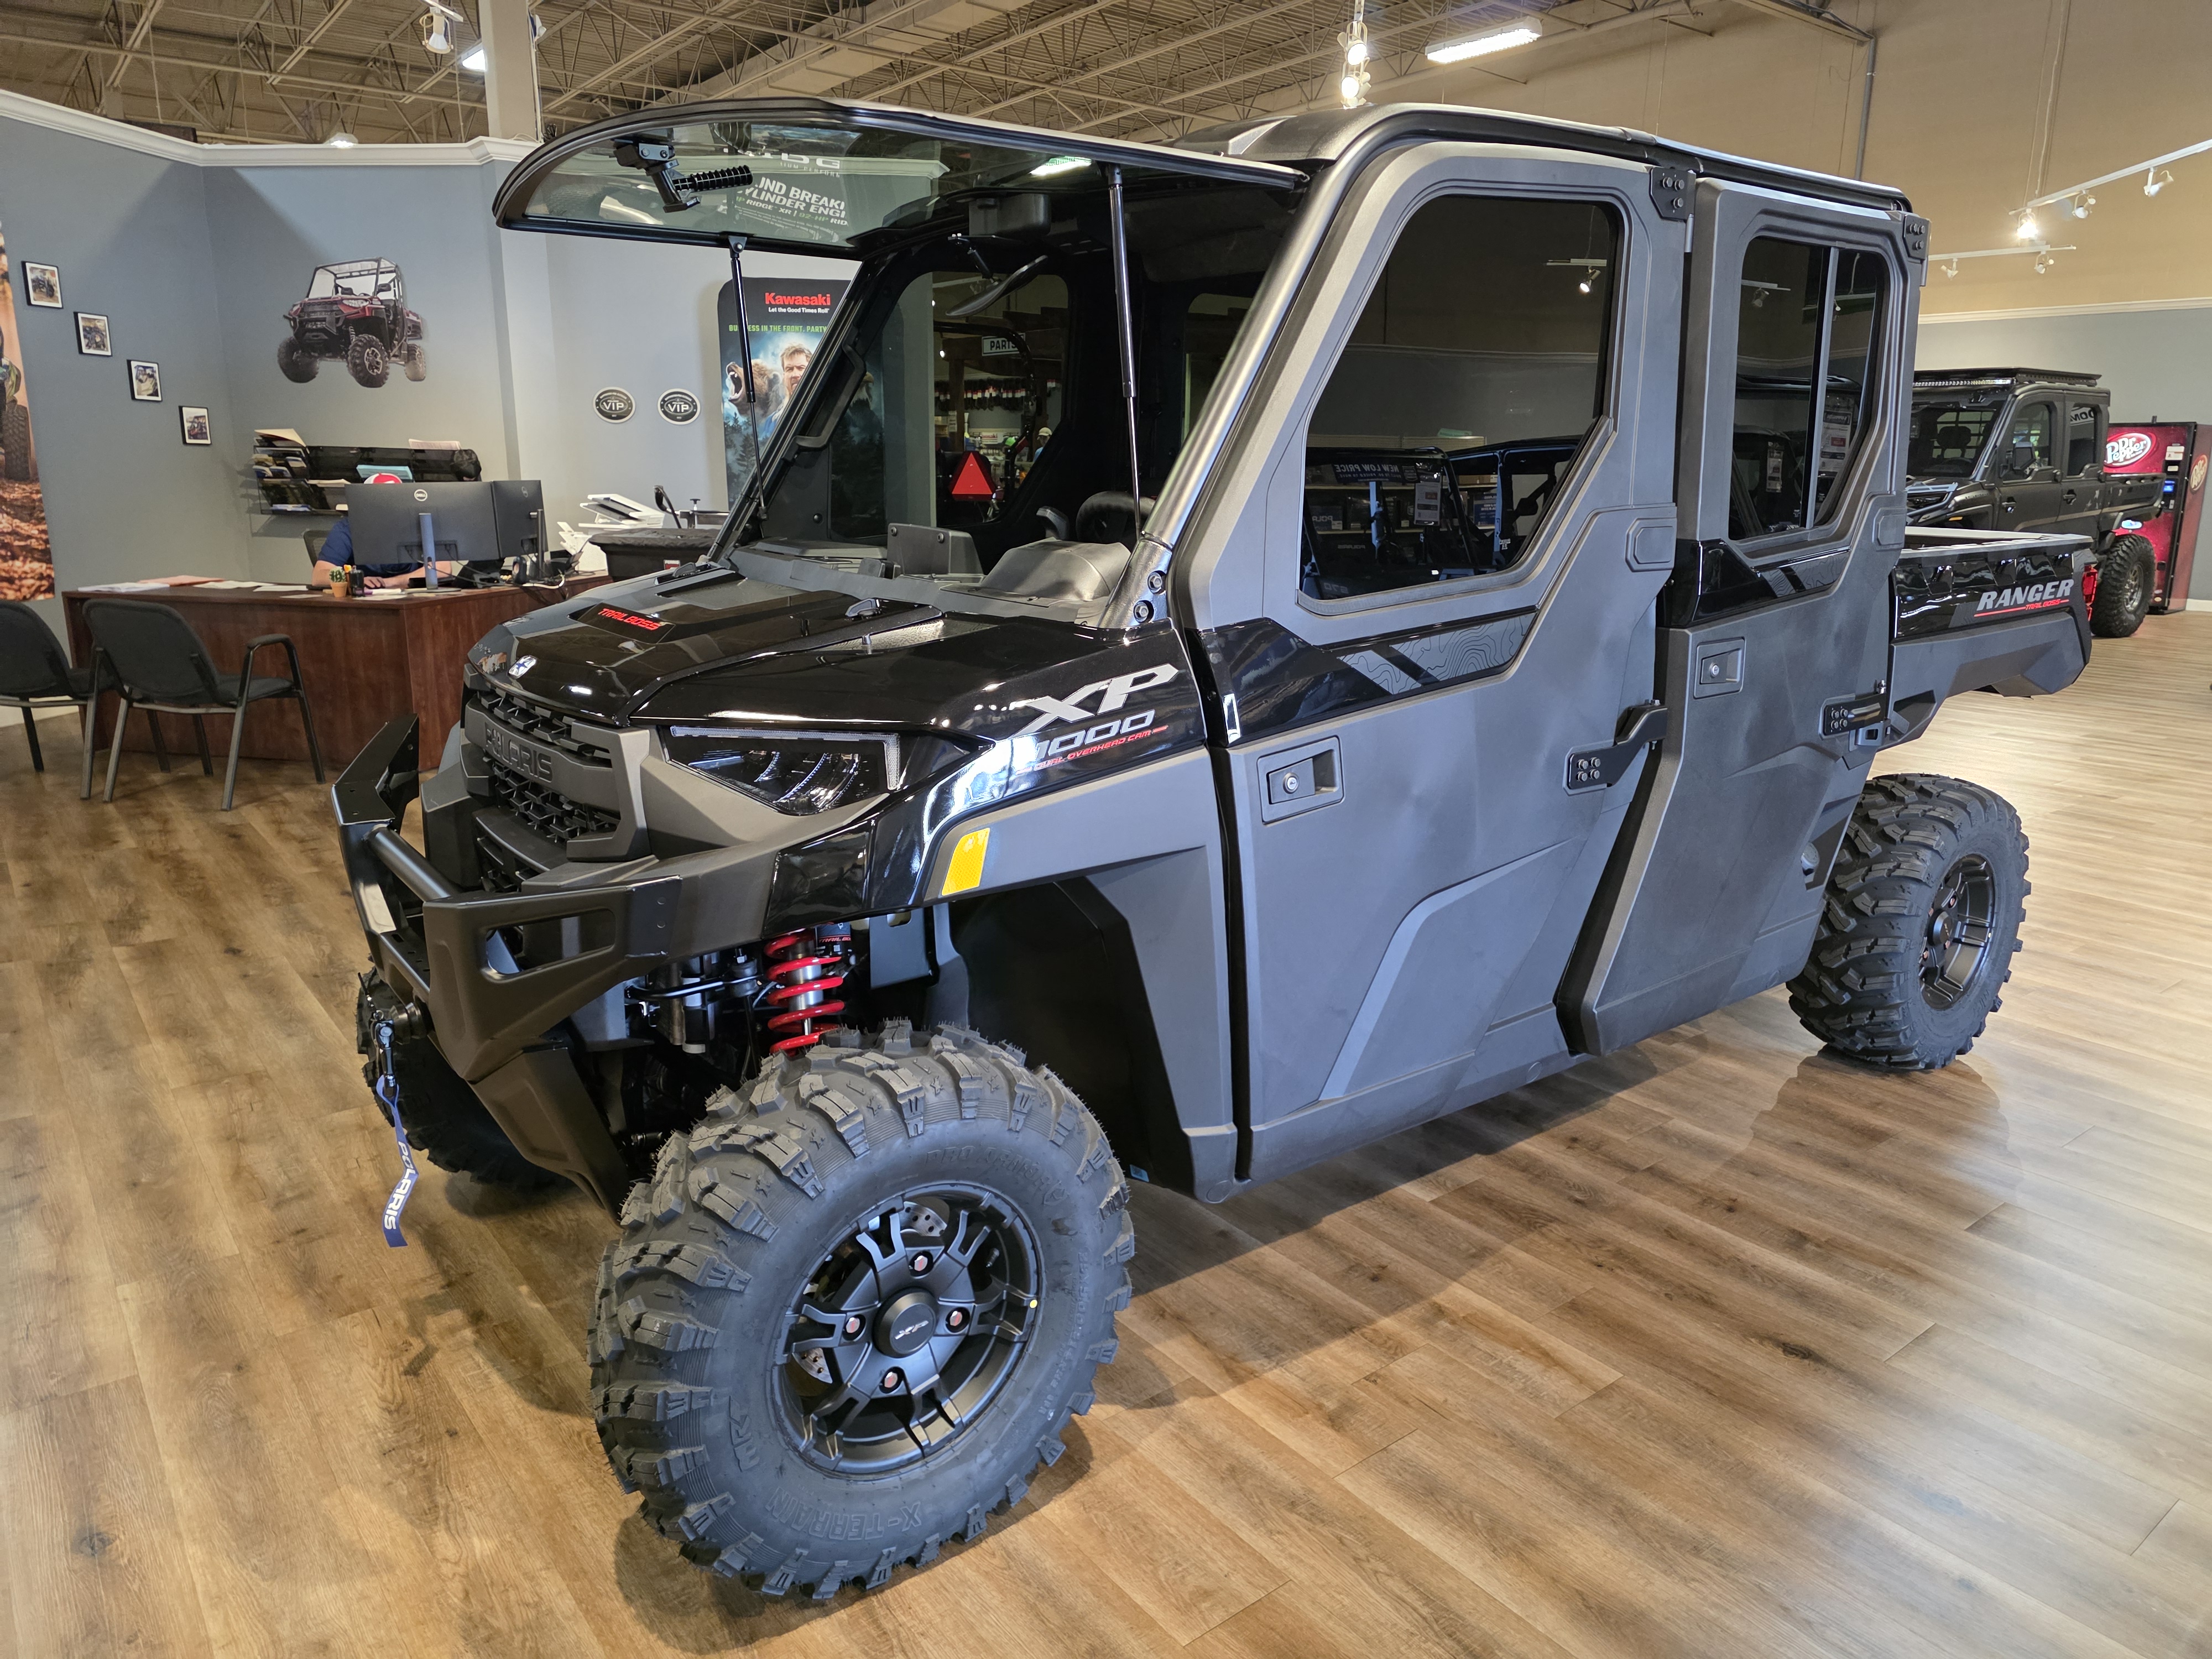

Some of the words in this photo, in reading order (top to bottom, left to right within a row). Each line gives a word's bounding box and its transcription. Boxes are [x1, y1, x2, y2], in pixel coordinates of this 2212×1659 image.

[765, 293, 831, 306] Kawasaki
[602, 401, 624, 410] VIP
[667, 404, 689, 412] VIP
[2106, 440, 2147, 463] Pepper
[1976, 579, 2074, 611] RANGER
[2042, 599, 2061, 607] BOSS
[598, 608, 628, 621] TRAIL
[623, 615, 661, 630] BOSS
[1009, 663, 1180, 739] XP
[1036, 709, 1156, 759] 1000
[485, 722, 553, 783] POLARIS
[1033, 757, 1065, 771] DUAL
[1067, 738, 1125, 760] OVERHEAD
[1126, 729, 1152, 742] CAM
[384, 1141, 416, 1230] POLARIS
[895, 1320, 929, 1340] XP
[765, 1486, 922, 1541] X-TERRAIN
